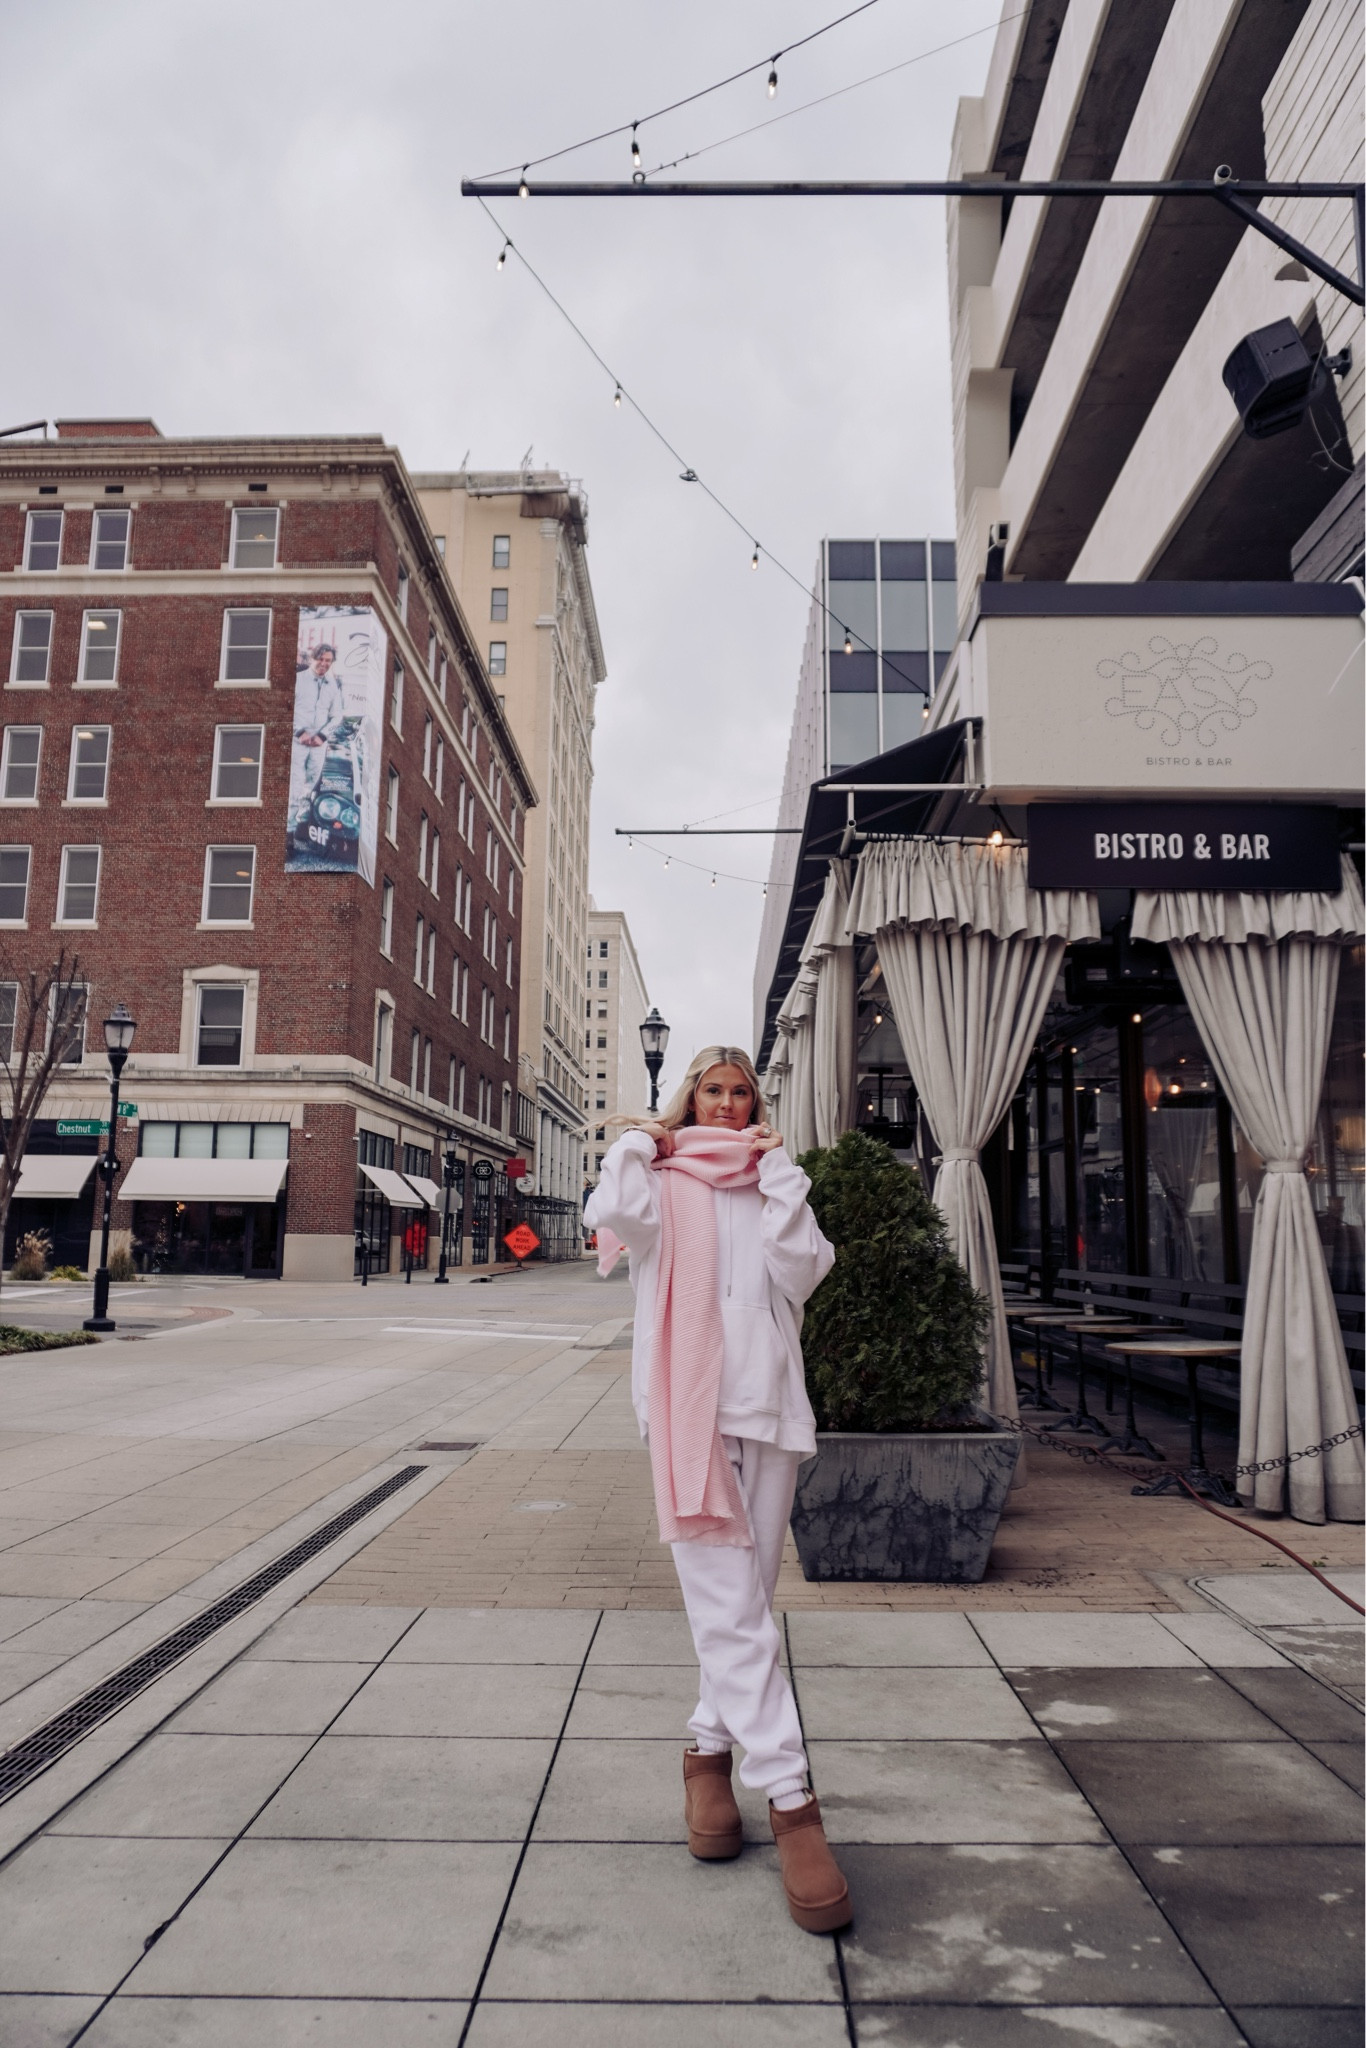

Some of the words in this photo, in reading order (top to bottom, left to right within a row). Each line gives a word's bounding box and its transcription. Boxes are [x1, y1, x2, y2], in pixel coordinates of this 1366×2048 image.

[1122, 674, 1252, 711] EASY
[1146, 757, 1190, 766] BISTRO
[1195, 757, 1203, 766] &
[1207, 757, 1232, 766] BAR
[308, 825, 330, 846] elf
[1095, 833, 1184, 859] BISTRO
[1193, 833, 1212, 859] &
[1221, 833, 1271, 860] BAR
[58, 1123, 91, 1133] Chestnut
